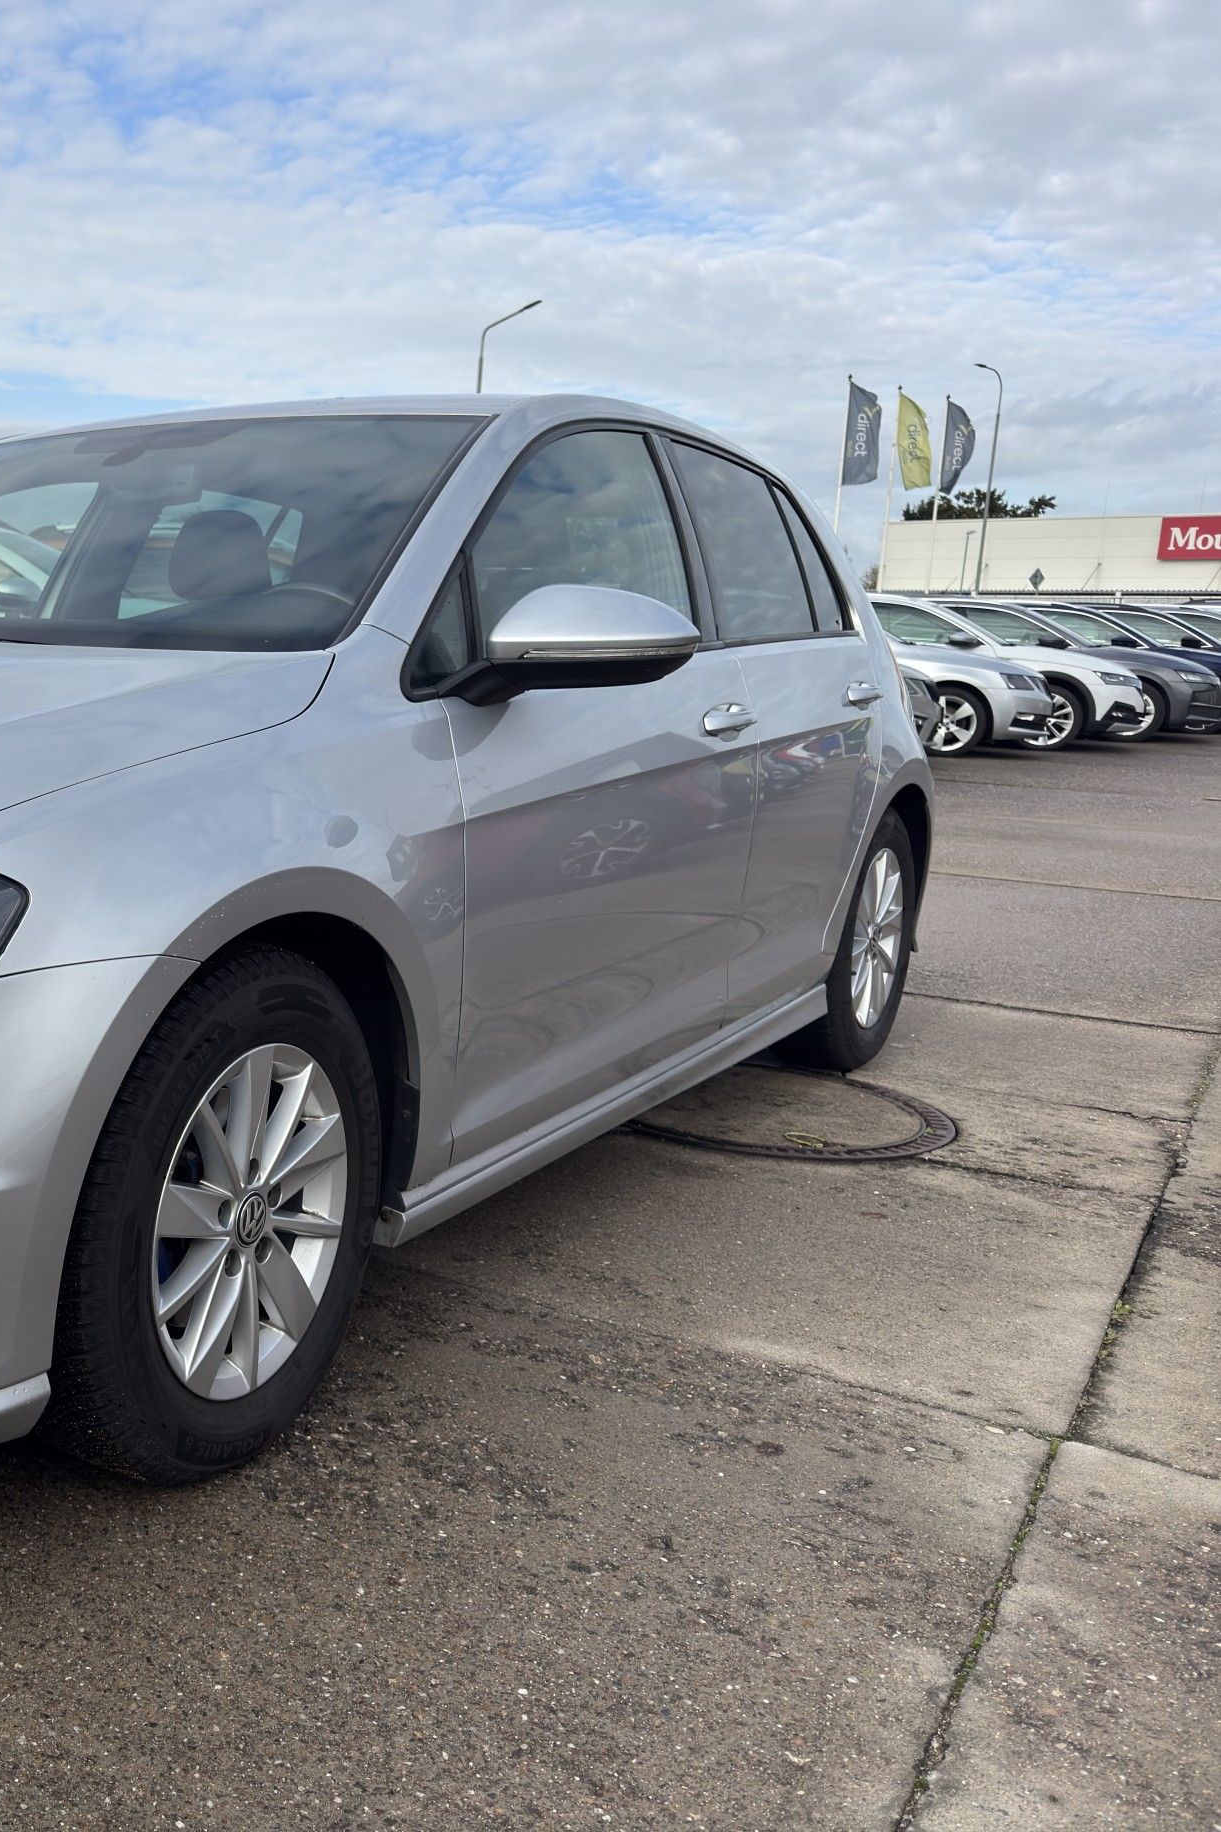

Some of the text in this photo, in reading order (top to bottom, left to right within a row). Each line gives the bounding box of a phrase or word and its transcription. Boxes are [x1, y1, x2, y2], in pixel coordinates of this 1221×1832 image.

[854, 413, 869, 457] direct
[907, 423, 922, 464] direct
[951, 430, 968, 471] direct
[194, 1431, 264, 1459] POLARIS
